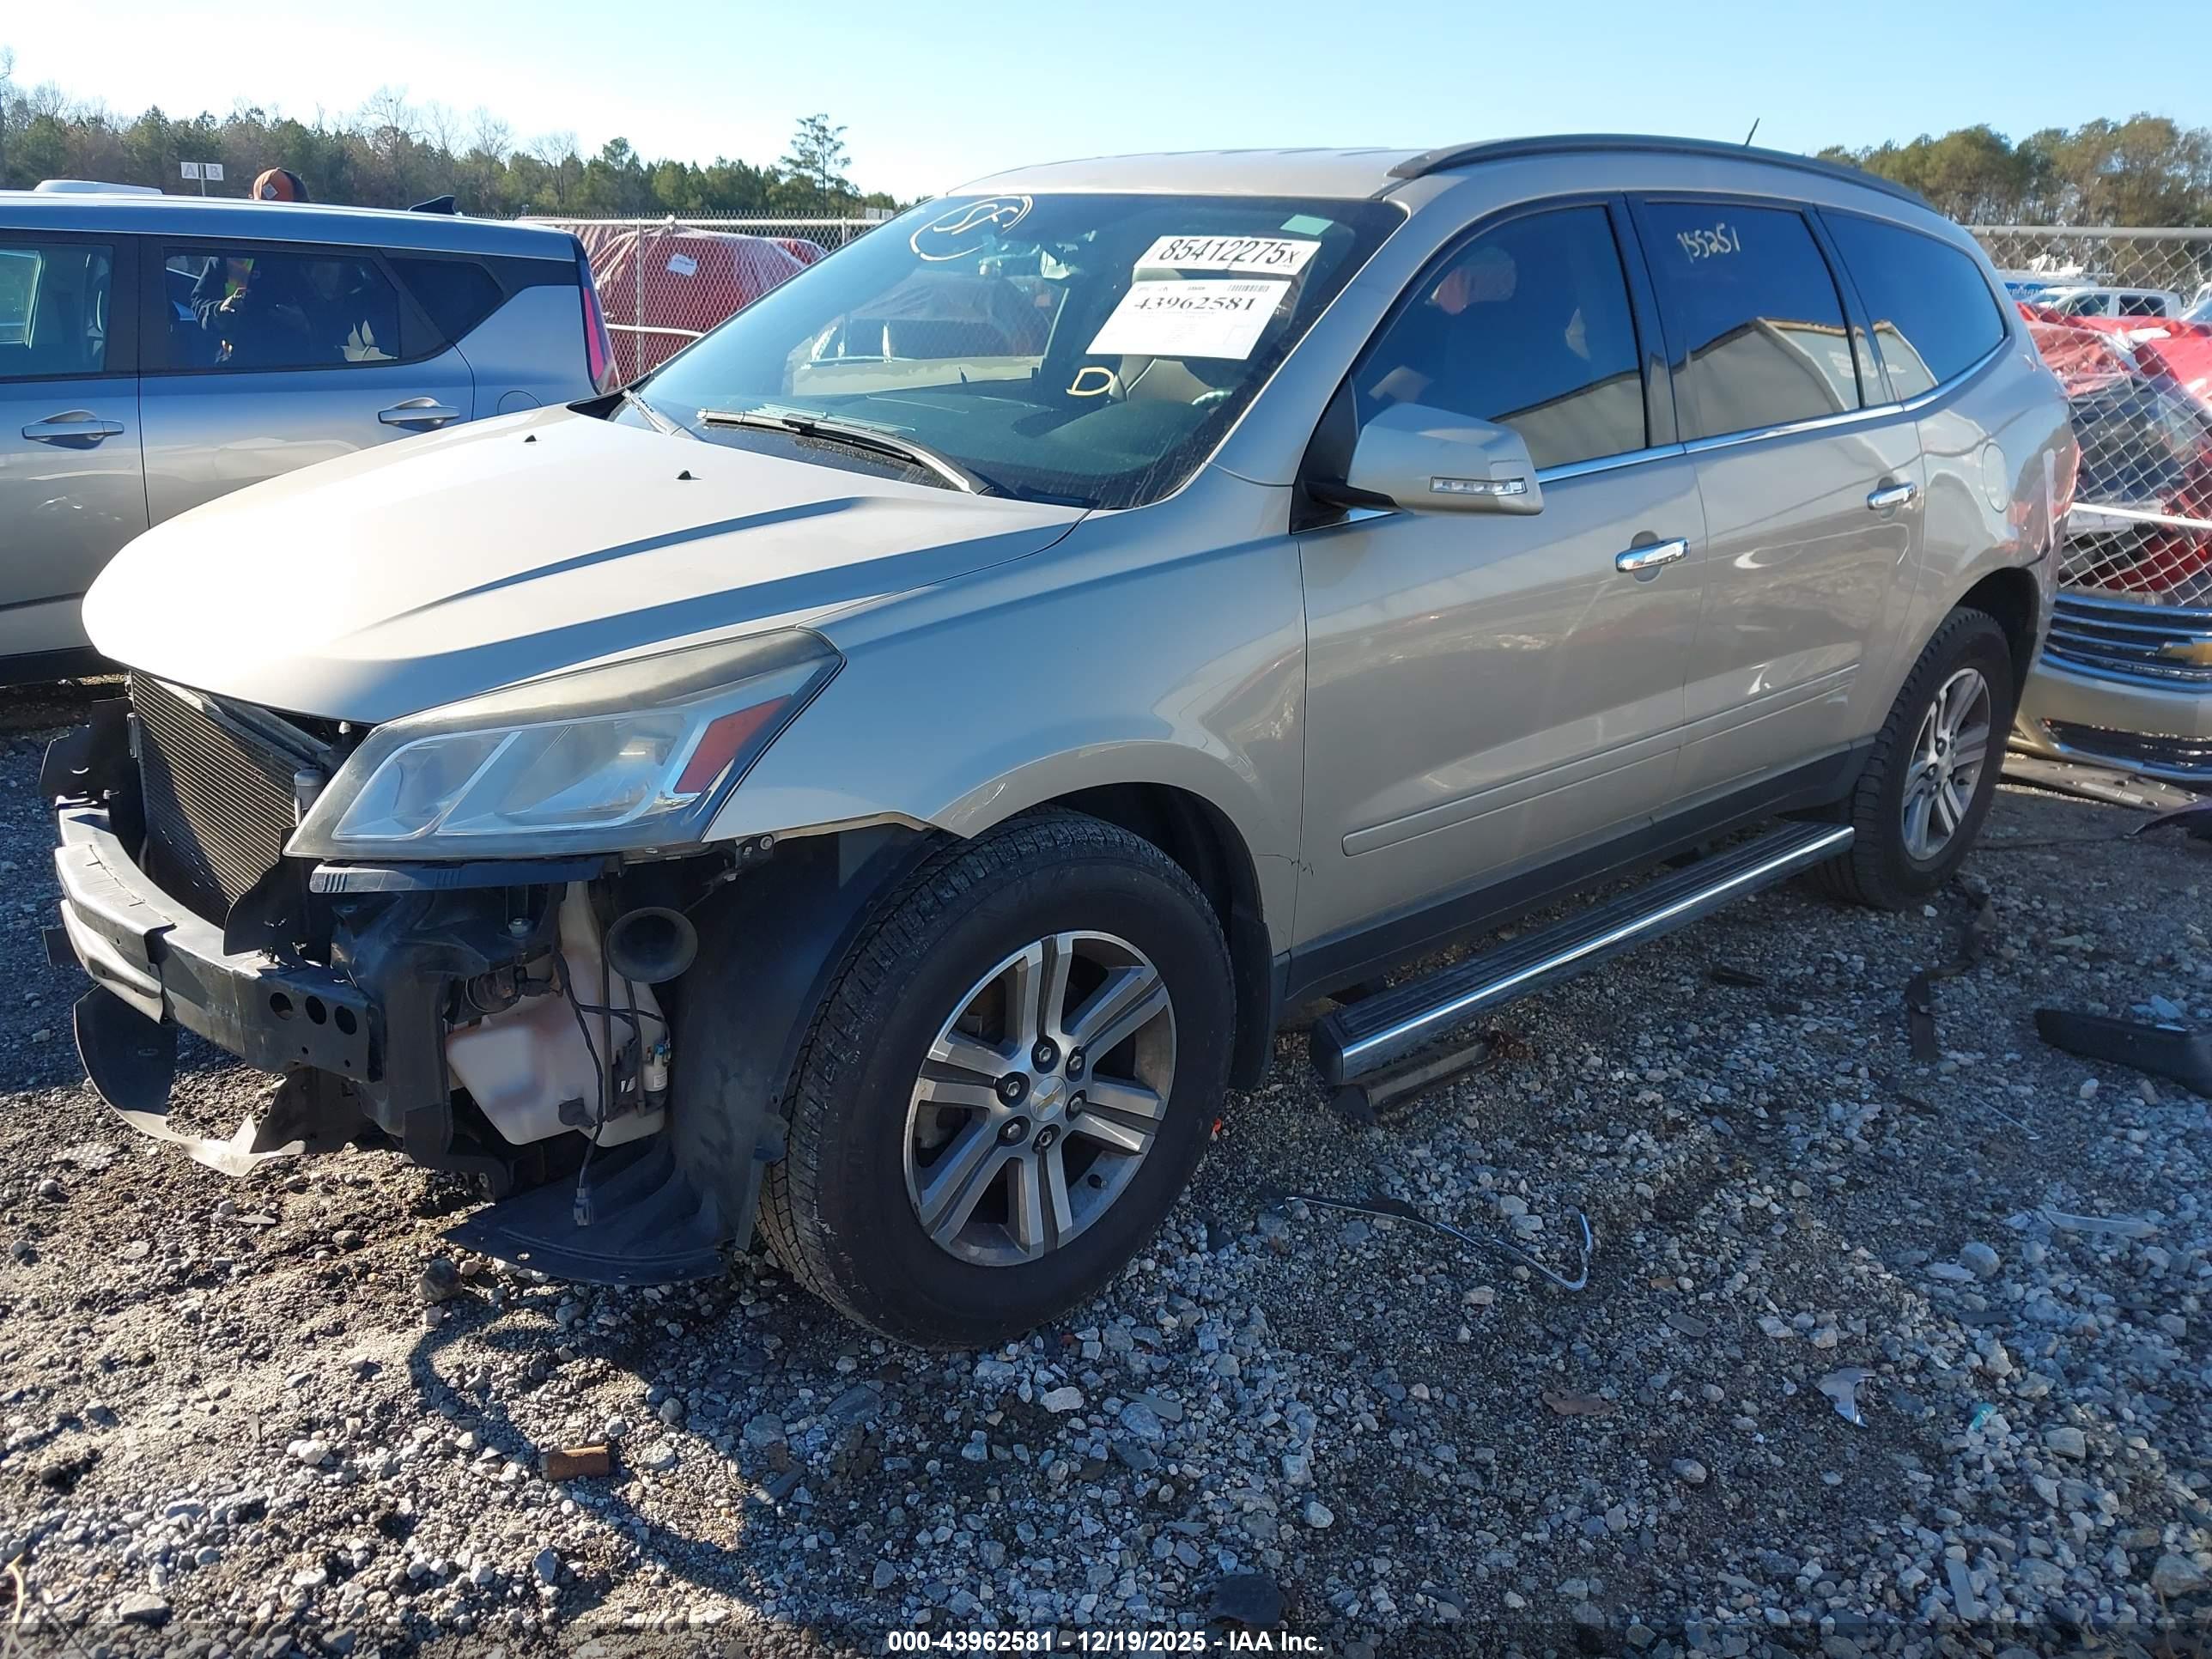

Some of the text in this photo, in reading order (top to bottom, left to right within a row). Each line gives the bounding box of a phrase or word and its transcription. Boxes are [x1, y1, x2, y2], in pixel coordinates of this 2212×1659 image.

[183, 163, 197, 177] A
[209, 165, 221, 179] B
[1133, 296, 1256, 311] 43962581
[1066, 367, 1115, 396] D
